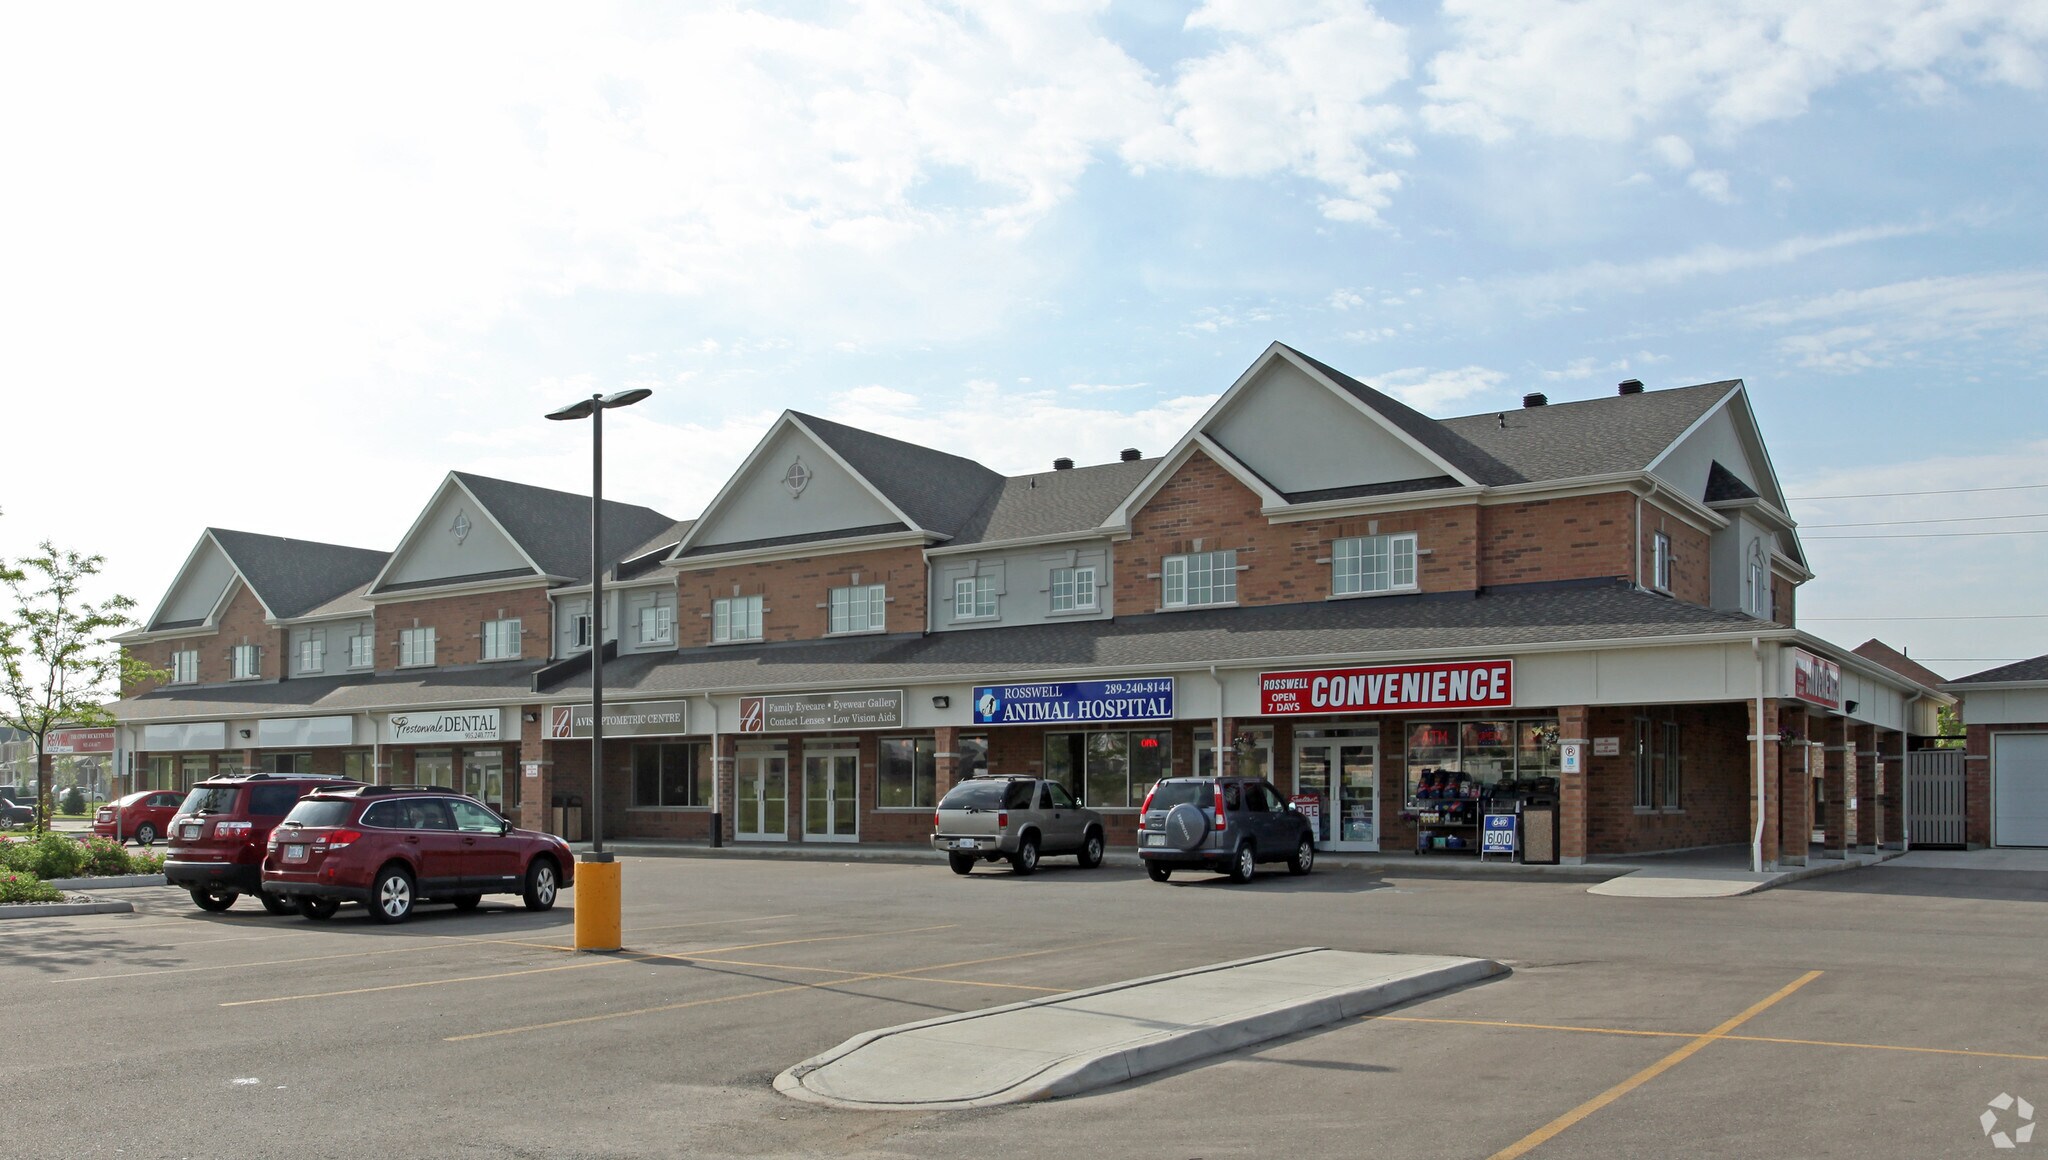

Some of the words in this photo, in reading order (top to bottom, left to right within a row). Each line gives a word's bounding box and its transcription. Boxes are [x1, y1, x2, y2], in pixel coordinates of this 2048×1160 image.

[1104, 681, 1171, 695] 289-240-8144
[1263, 677, 1309, 690] ROSSWELL
[1311, 667, 1506, 708] CONVENIENCE
[1004, 686, 1063, 699] ROSSWELL
[1271, 692, 1296, 702] OPEN
[769, 702, 794, 714] Family
[796, 702, 826, 714] Eyecare
[833, 700, 866, 711] Eyewear
[867, 698, 897, 709] Gallery
[1002, 700, 1074, 721] ANIMAL
[1077, 697, 1171, 719] HOSPITAL
[1268, 703, 1274, 712] 7
[1276, 702, 1300, 711] DAYS
[444, 715, 497, 732] DENTAL
[602, 714, 647, 726] PTOMETRIC
[647, 713, 681, 724] CENTRE
[770, 717, 798, 726] Contact
[800, 716, 826, 725] Lenses
[833, 714, 850, 724] Low
[852, 713, 876, 723] Vision
[877, 712, 896, 722] Aids
[391, 716, 443, 739] Prestonvale
[1141, 738, 1158, 748] OPEN
[1422, 730, 1449, 745] ATM
